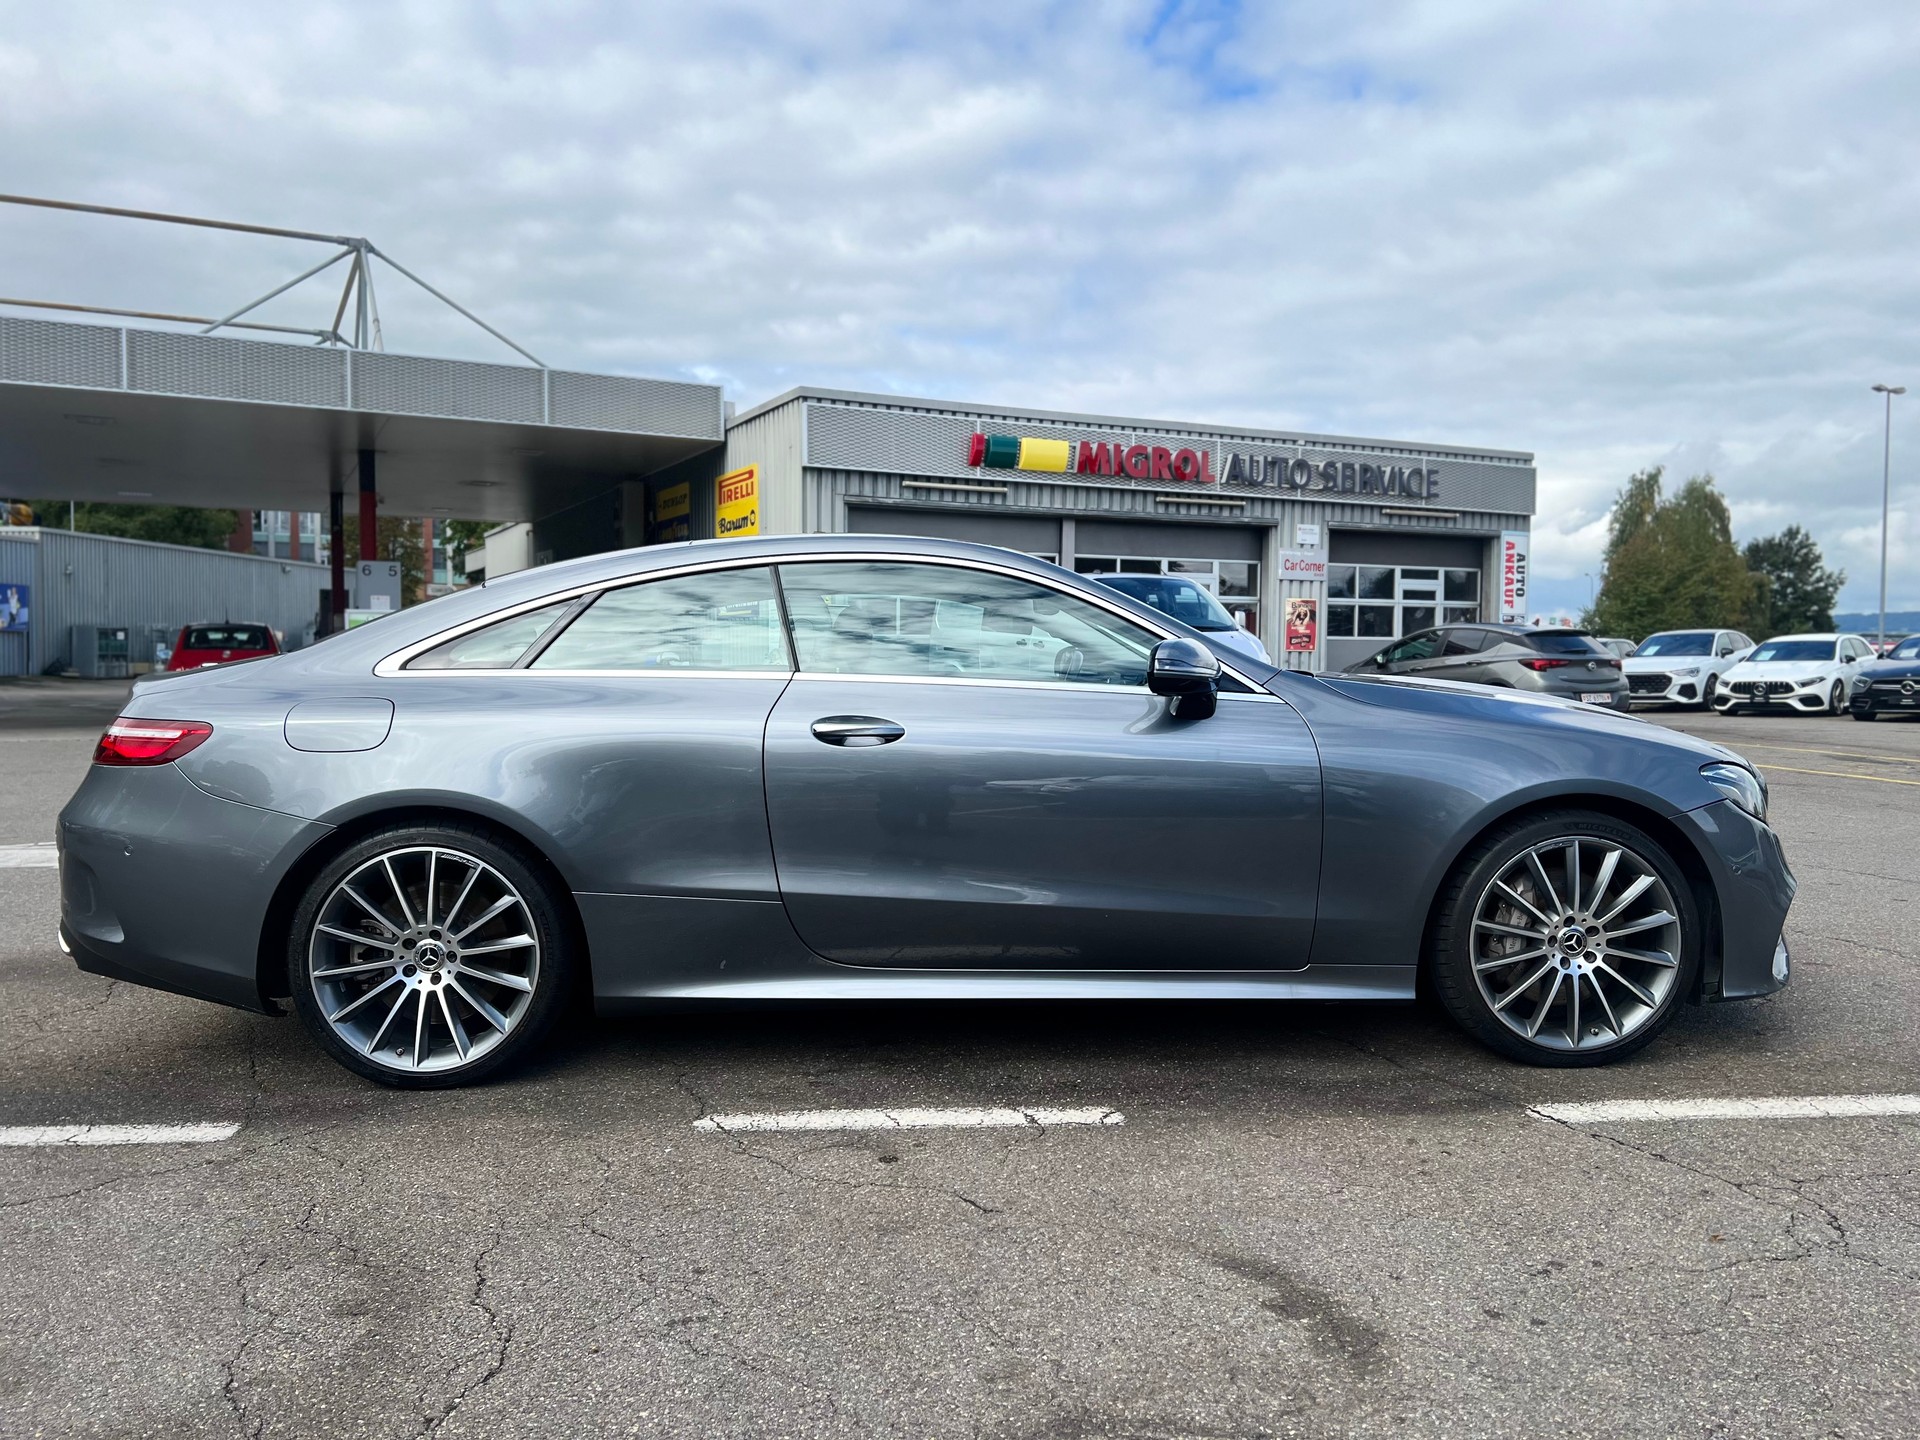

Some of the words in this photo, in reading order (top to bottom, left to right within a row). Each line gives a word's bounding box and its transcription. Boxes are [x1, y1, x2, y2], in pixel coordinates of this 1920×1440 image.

[718, 469, 754, 505] PIRELLI
[1076, 440, 1216, 483] MIGROL
[1222, 453, 1312, 489] AUTO
[1319, 460, 1440, 498] SERVICE
[719, 516, 748, 534] Barum
[362, 564, 372, 576] 6
[388, 565, 398, 577] 5
[1284, 558, 1298, 571] Car
[1299, 559, 1325, 572] Corner
[1503, 540, 1516, 609] ANKAUF
[1515, 552, 1526, 598] AUTO
